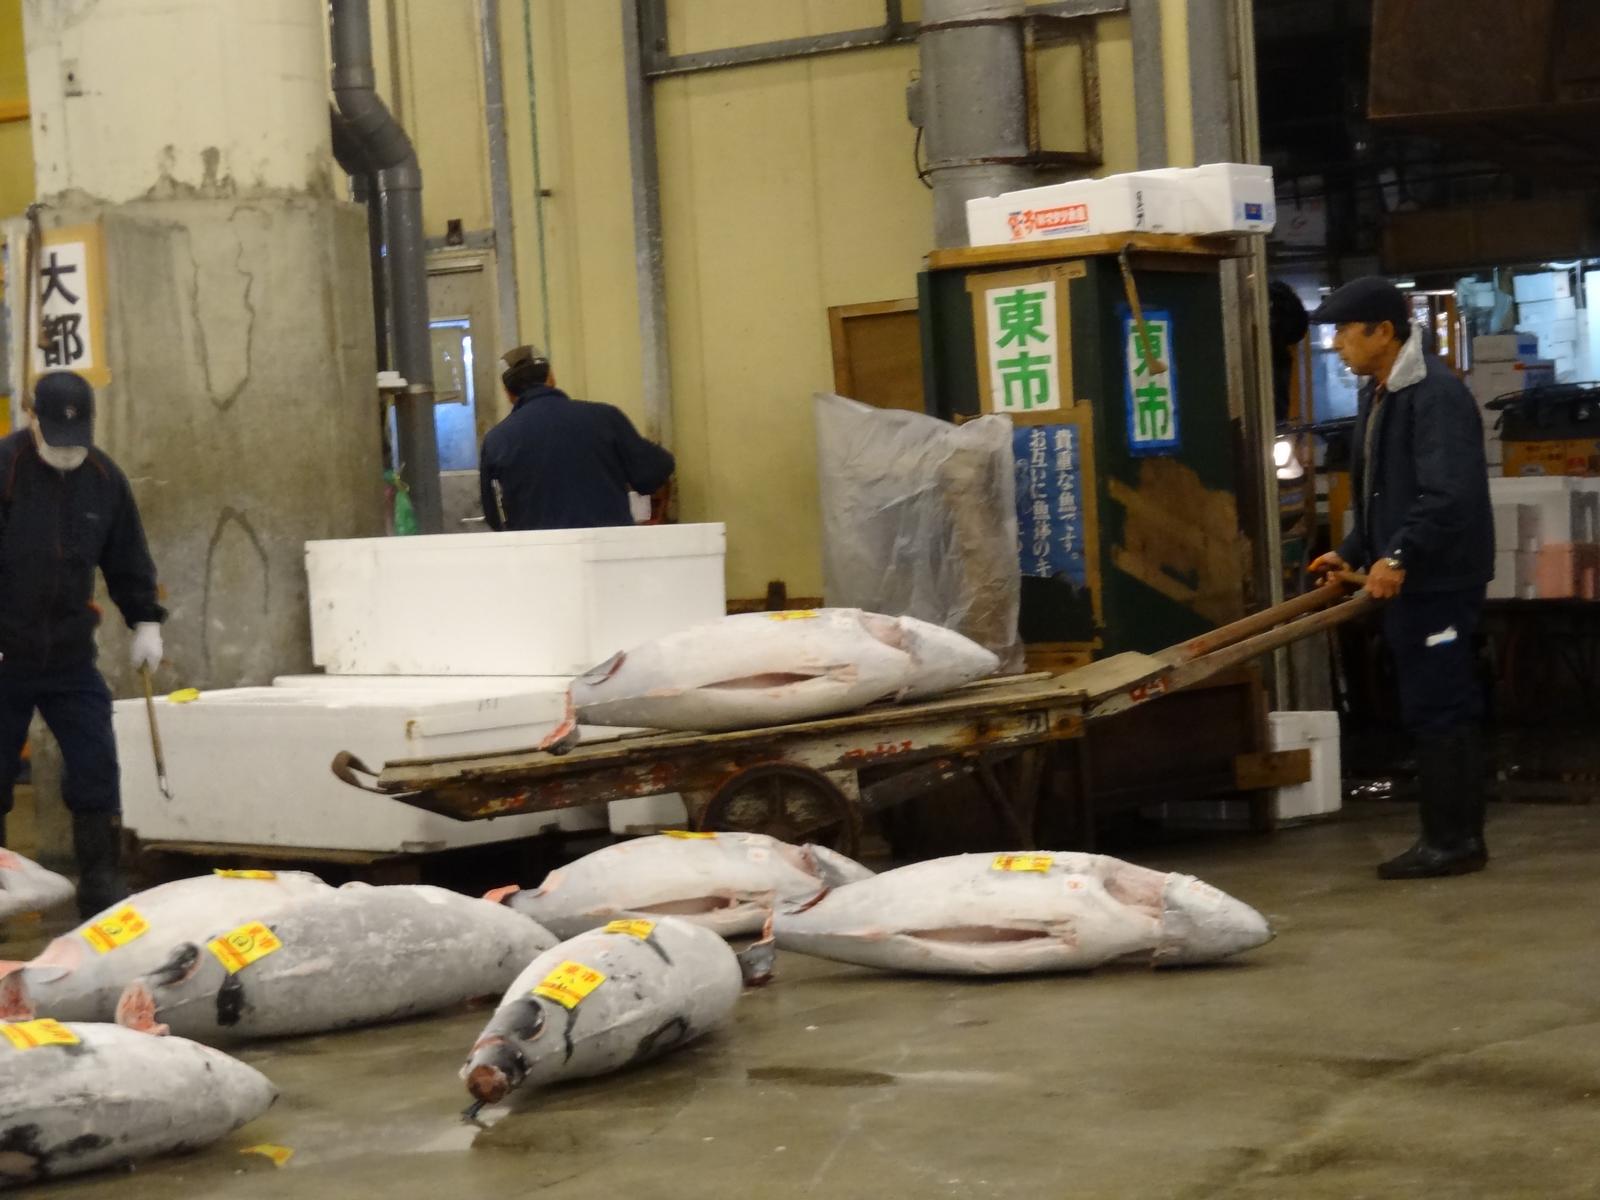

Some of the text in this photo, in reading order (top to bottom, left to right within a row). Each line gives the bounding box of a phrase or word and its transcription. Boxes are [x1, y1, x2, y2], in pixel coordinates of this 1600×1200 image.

[40, 252, 84, 367] 大都
[993, 288, 1053, 410] 東市
[1130, 321, 1169, 439] 東市
